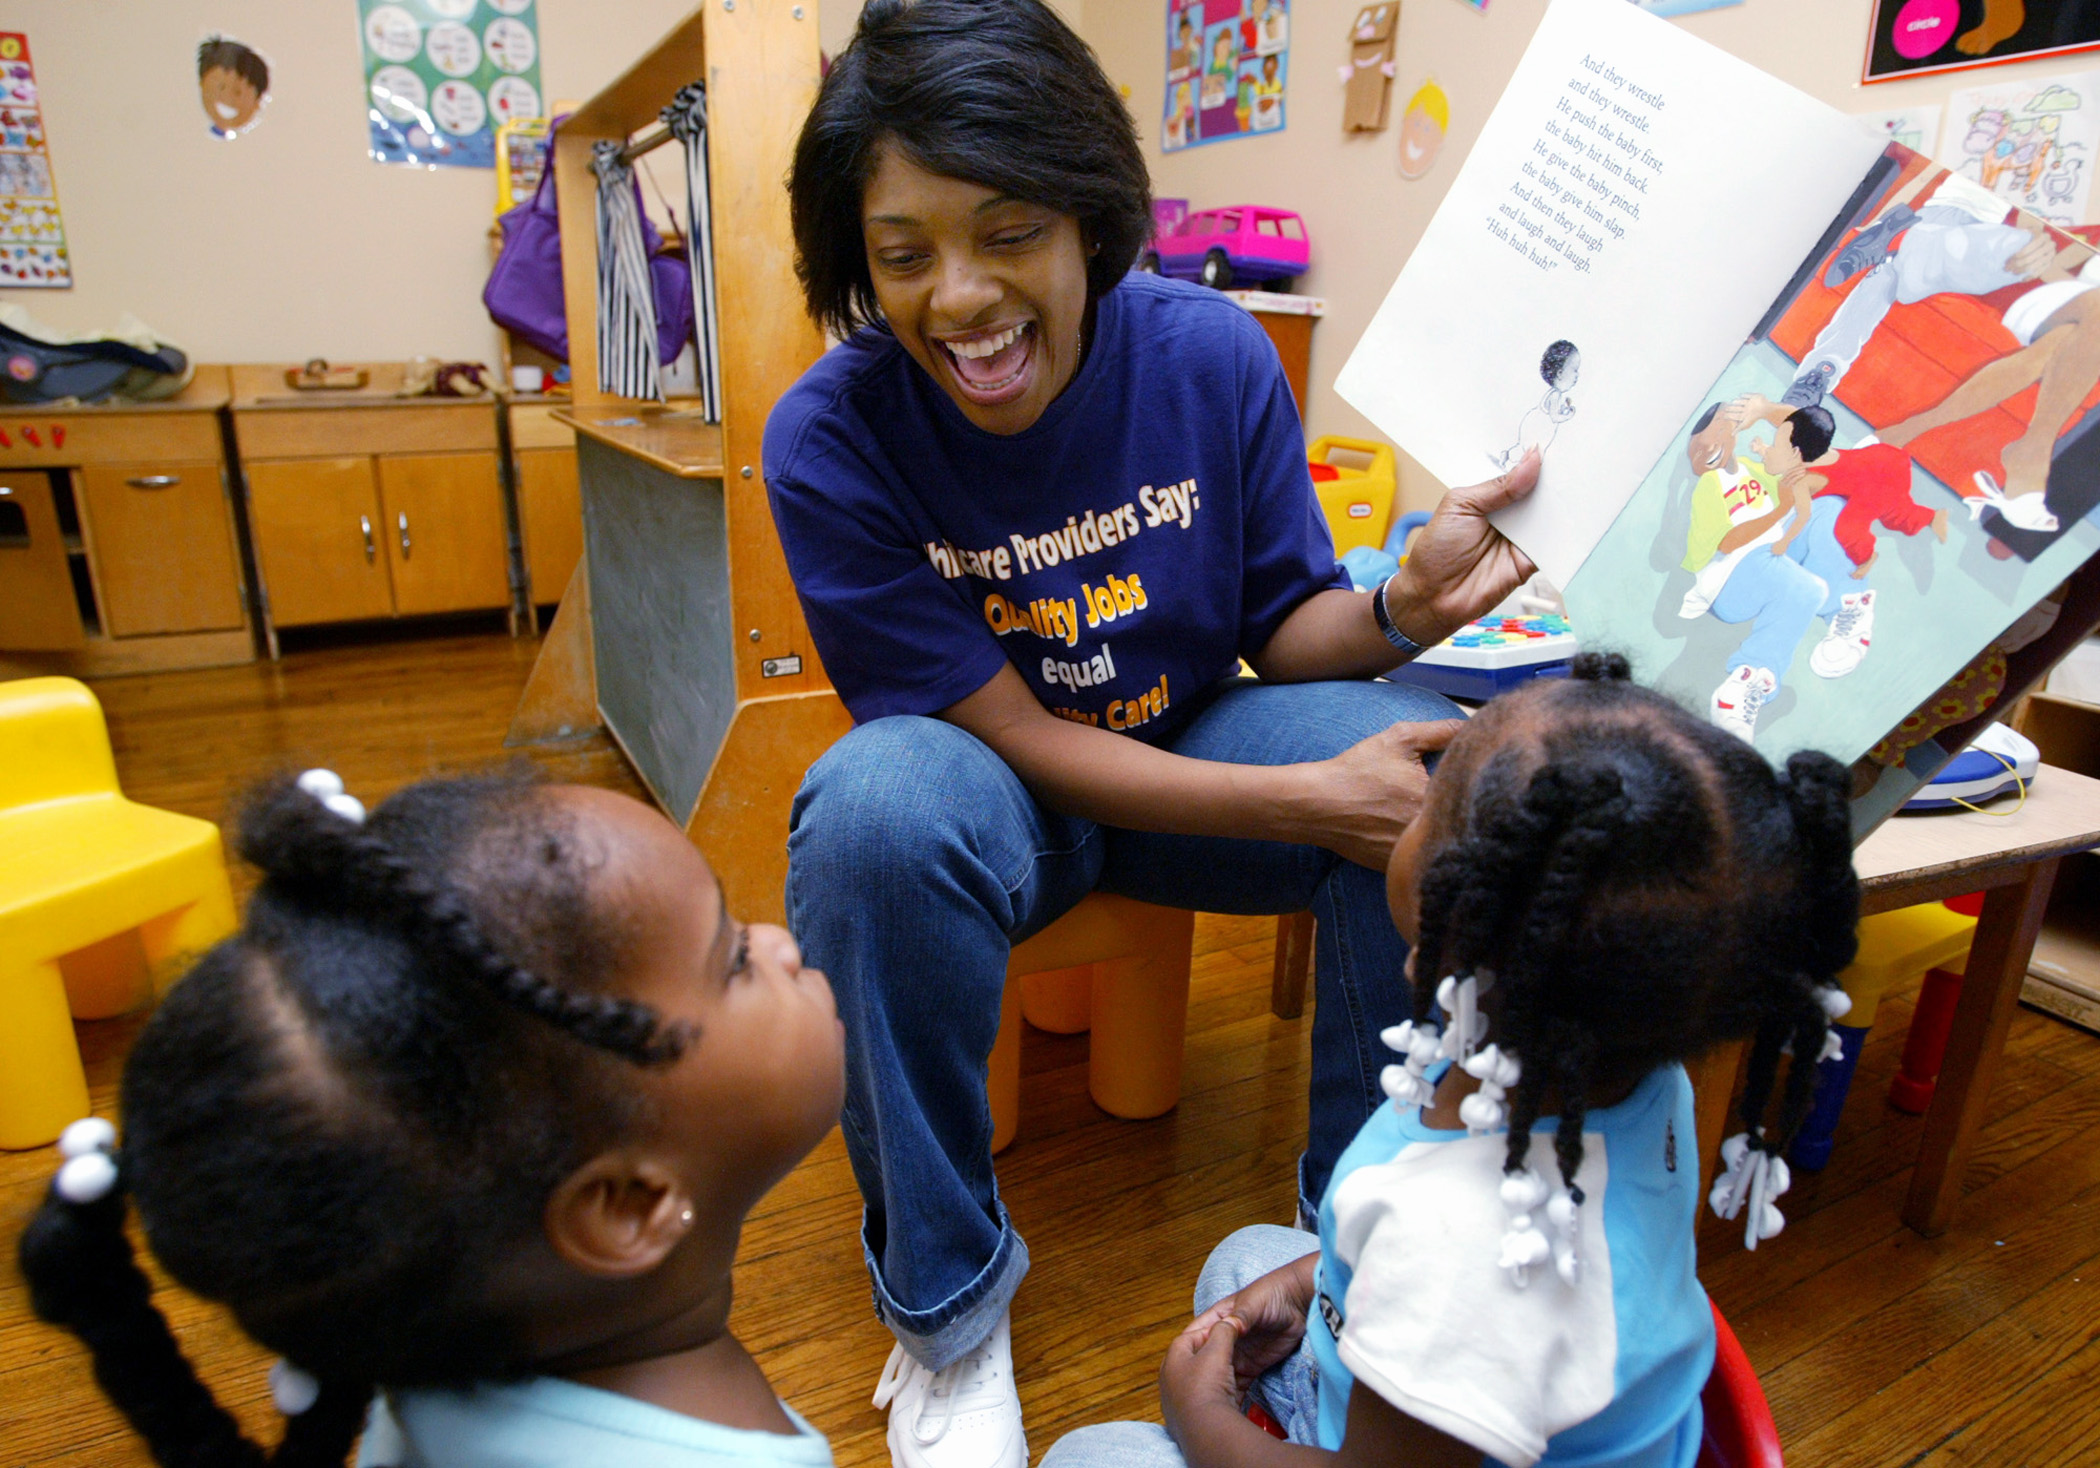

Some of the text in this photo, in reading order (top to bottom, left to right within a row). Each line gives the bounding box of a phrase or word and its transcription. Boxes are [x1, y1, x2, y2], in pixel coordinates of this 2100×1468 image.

[1568, 78, 1591, 96] and
[1588, 87, 1612, 112] they
[1579, 54, 1665, 111] And they wrestle
[1545, 119, 1562, 137] the
[1561, 127, 1587, 155] baby
[1586, 143, 1603, 163] hit
[1601, 153, 1623, 177] him
[1556, 96, 1572, 115] He
[1569, 110, 1597, 131] push
[1597, 123, 1615, 142] the
[1615, 131, 1642, 160] baby
[1521, 161, 1538, 178] the
[1538, 169, 1564, 197] baby
[1559, 191, 1583, 209] give
[1583, 200, 1604, 224] him
[1532, 138, 1549, 157] He
[1546, 152, 1569, 170] give
[1569, 164, 1586, 182] the
[1586, 173, 1613, 201] baby
[1498, 203, 1520, 220] and
[1517, 212, 1544, 239] laugh
[1543, 234, 1566, 253] and
[1508, 233, 1528, 256] huh
[1509, 181, 1604, 253] And then they laugh
[1739, 479, 1762, 505] 29
[1009, 502, 1140, 575] Providers
[1081, 573, 1148, 629] Jobs
[1041, 643, 1117, 693] equal
[1106, 673, 1170, 731] Care!
